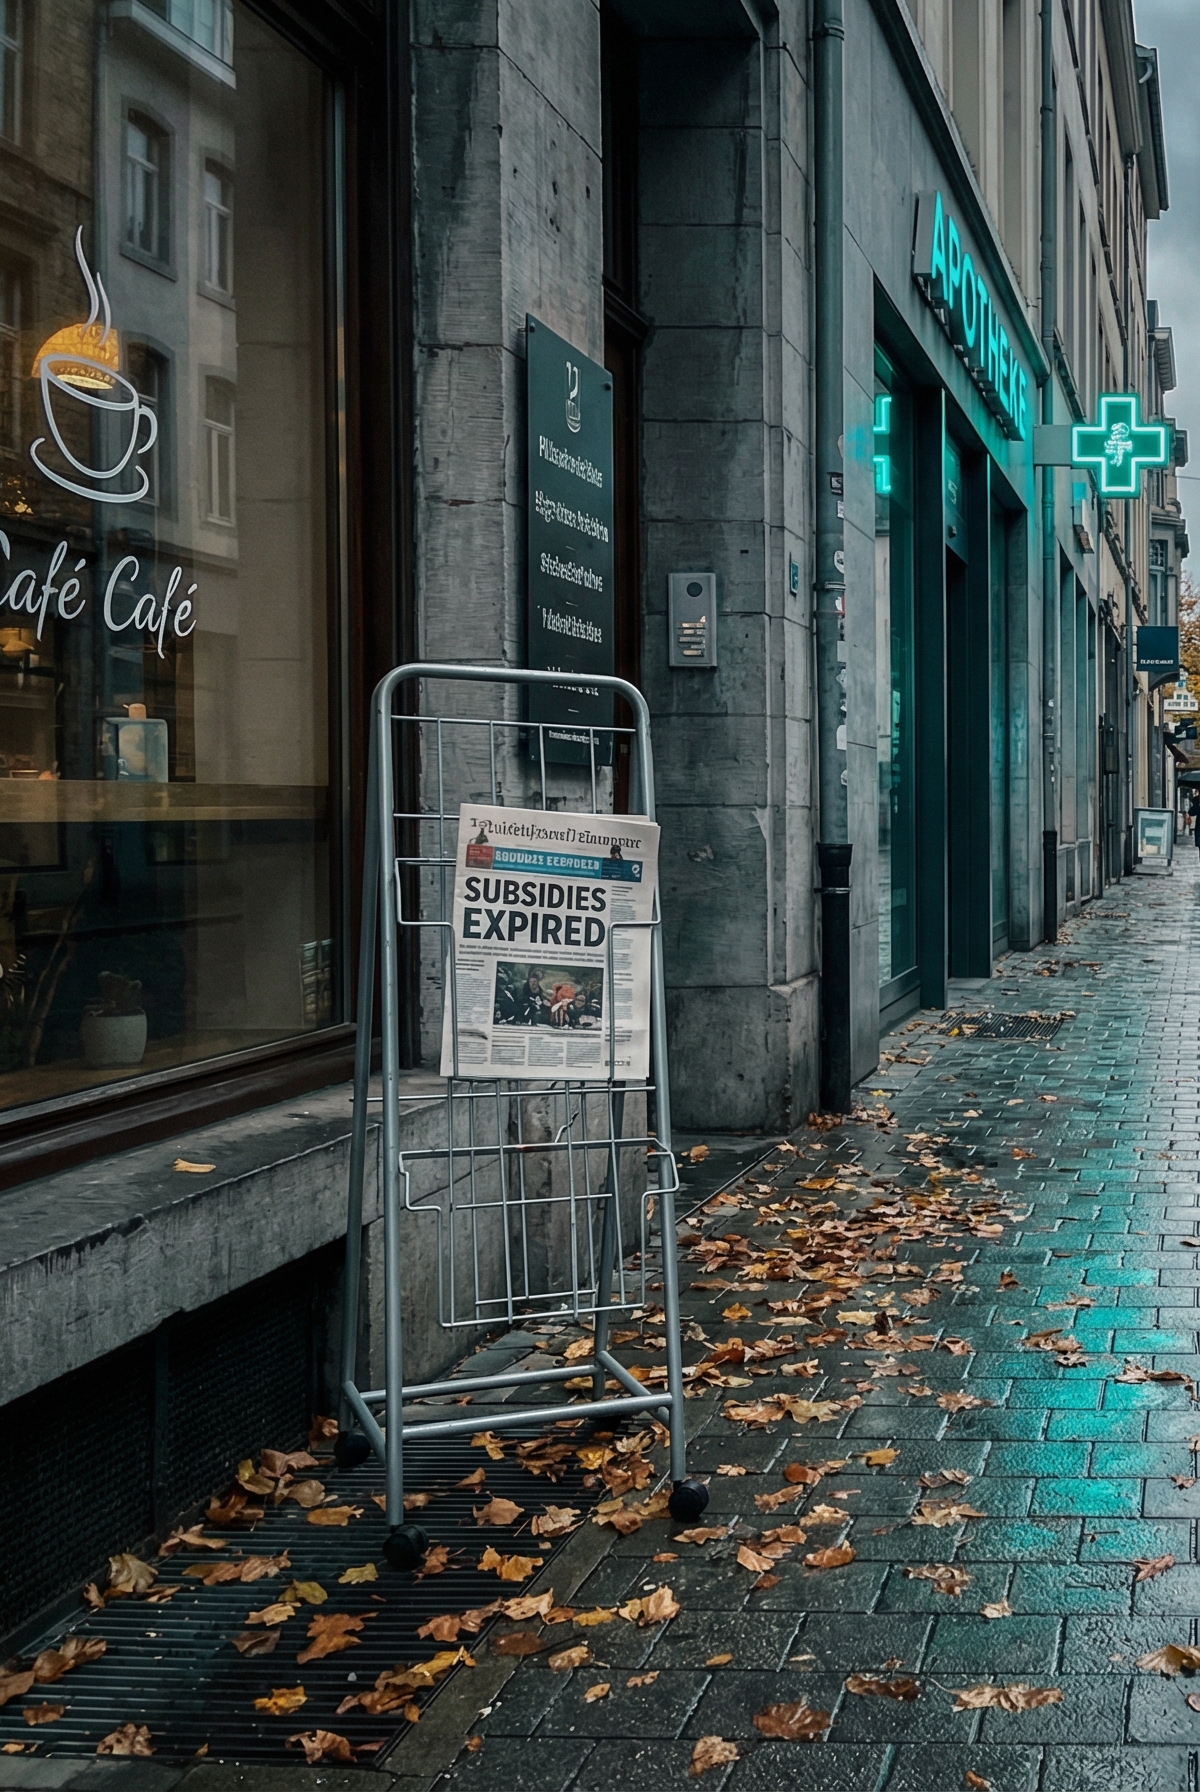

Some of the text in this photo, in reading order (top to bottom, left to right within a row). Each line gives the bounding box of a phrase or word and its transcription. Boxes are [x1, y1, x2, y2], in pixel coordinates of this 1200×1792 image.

[931, 190, 1027, 441] APOTHEKE
[103, 555, 198, 659] Café
[462, 907, 606, 947] EXPIRED
[463, 876, 607, 912] SUBSIDIES
